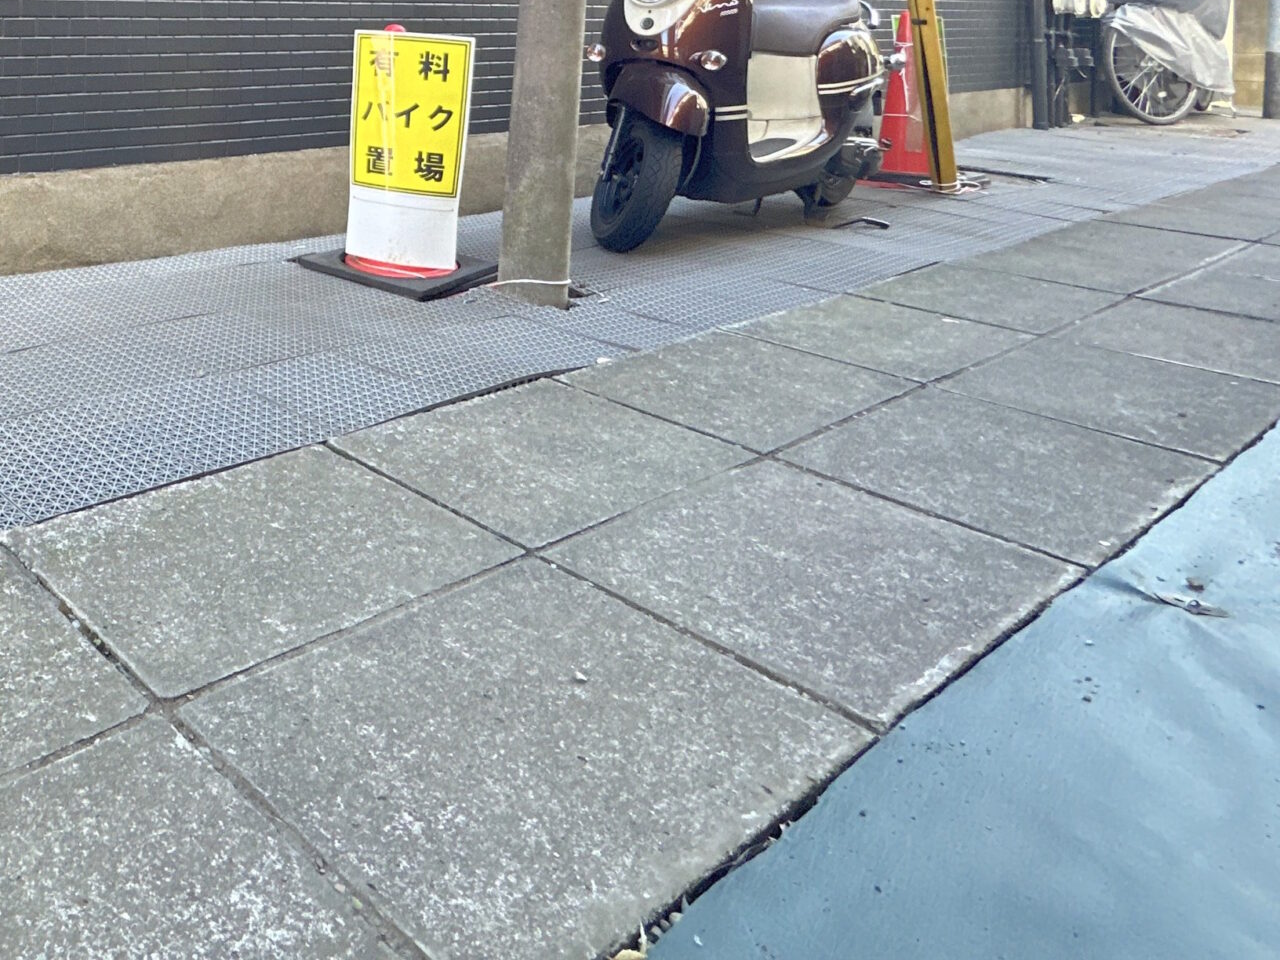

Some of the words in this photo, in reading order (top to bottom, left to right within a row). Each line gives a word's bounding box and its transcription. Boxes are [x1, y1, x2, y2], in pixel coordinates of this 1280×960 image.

[369, 49, 450, 82] 有料
[362, 100, 454, 132] バイク
[366, 145, 445, 182] 置場
